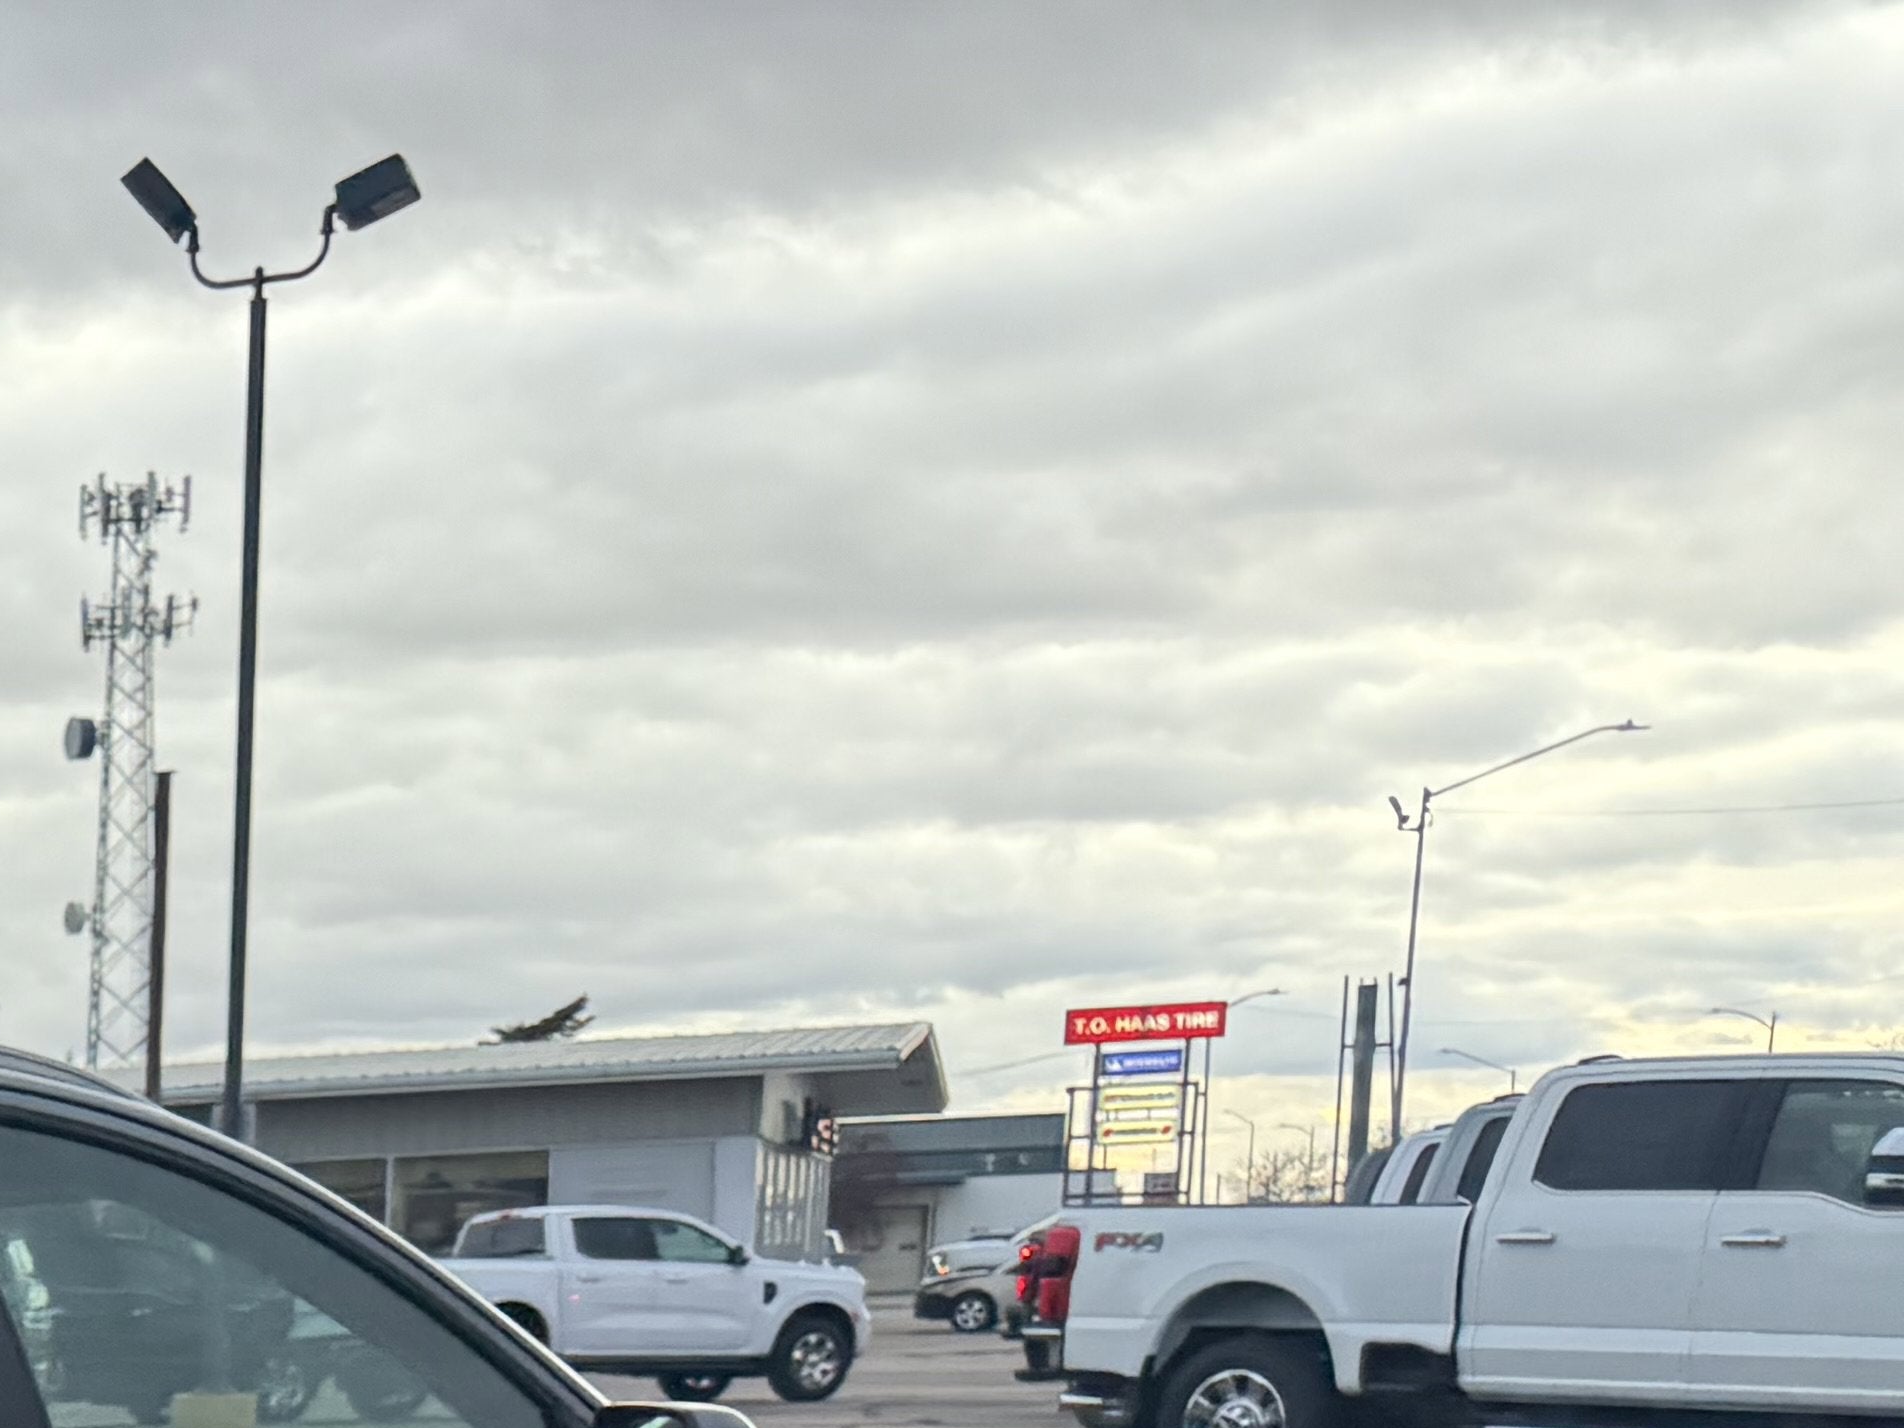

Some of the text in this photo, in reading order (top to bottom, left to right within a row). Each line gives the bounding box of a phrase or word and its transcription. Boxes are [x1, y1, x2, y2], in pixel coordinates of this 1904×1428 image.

[1073, 1010, 1219, 1035] T.O. HAAS TIRE
